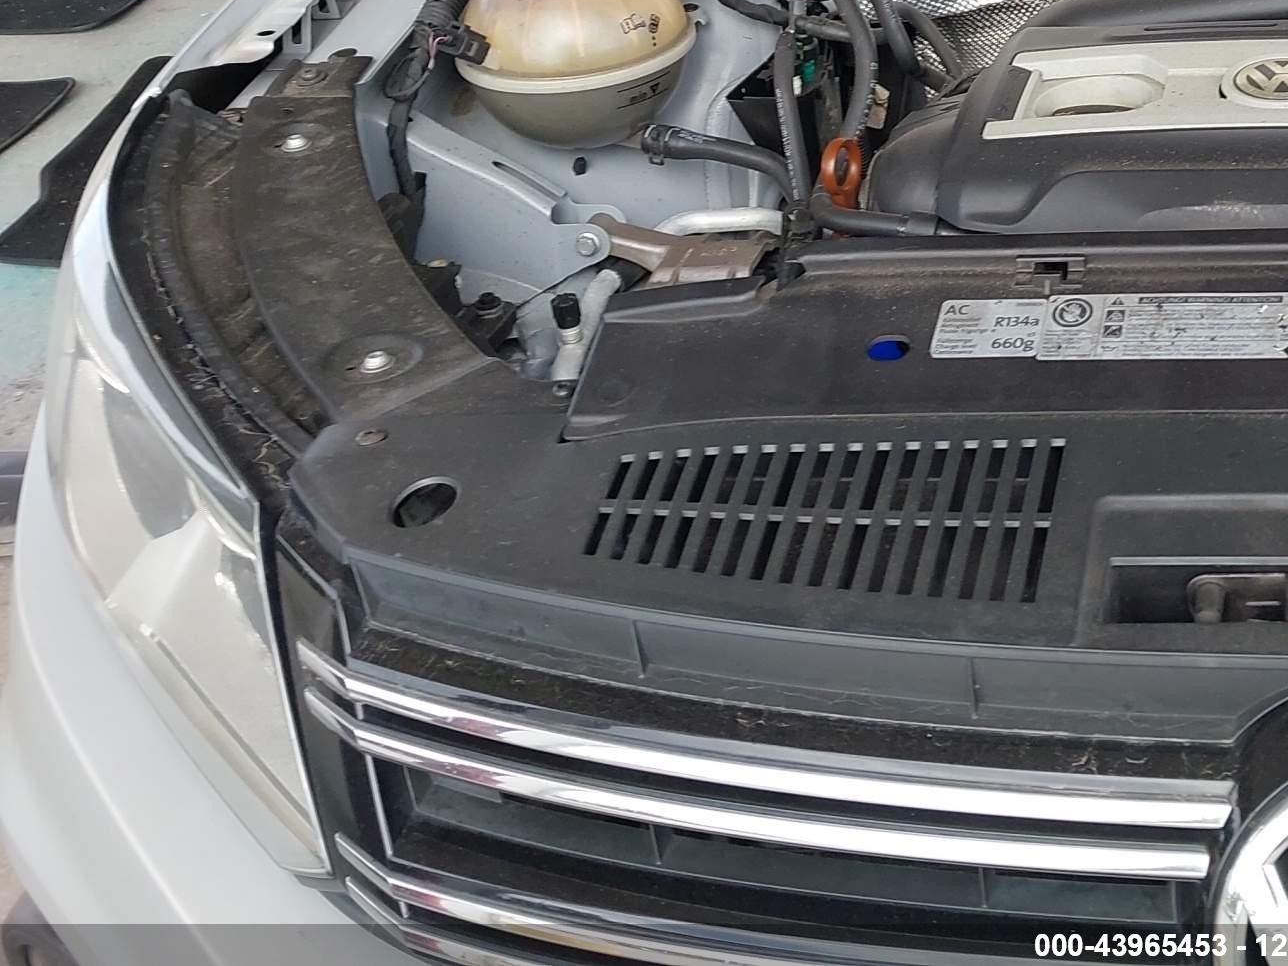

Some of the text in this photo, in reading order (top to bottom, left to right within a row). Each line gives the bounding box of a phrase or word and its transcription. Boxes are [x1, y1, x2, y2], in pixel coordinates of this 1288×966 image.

[944, 304, 970, 316] AC
[993, 315, 1040, 328] R134a
[991, 337, 1034, 352] 660g
